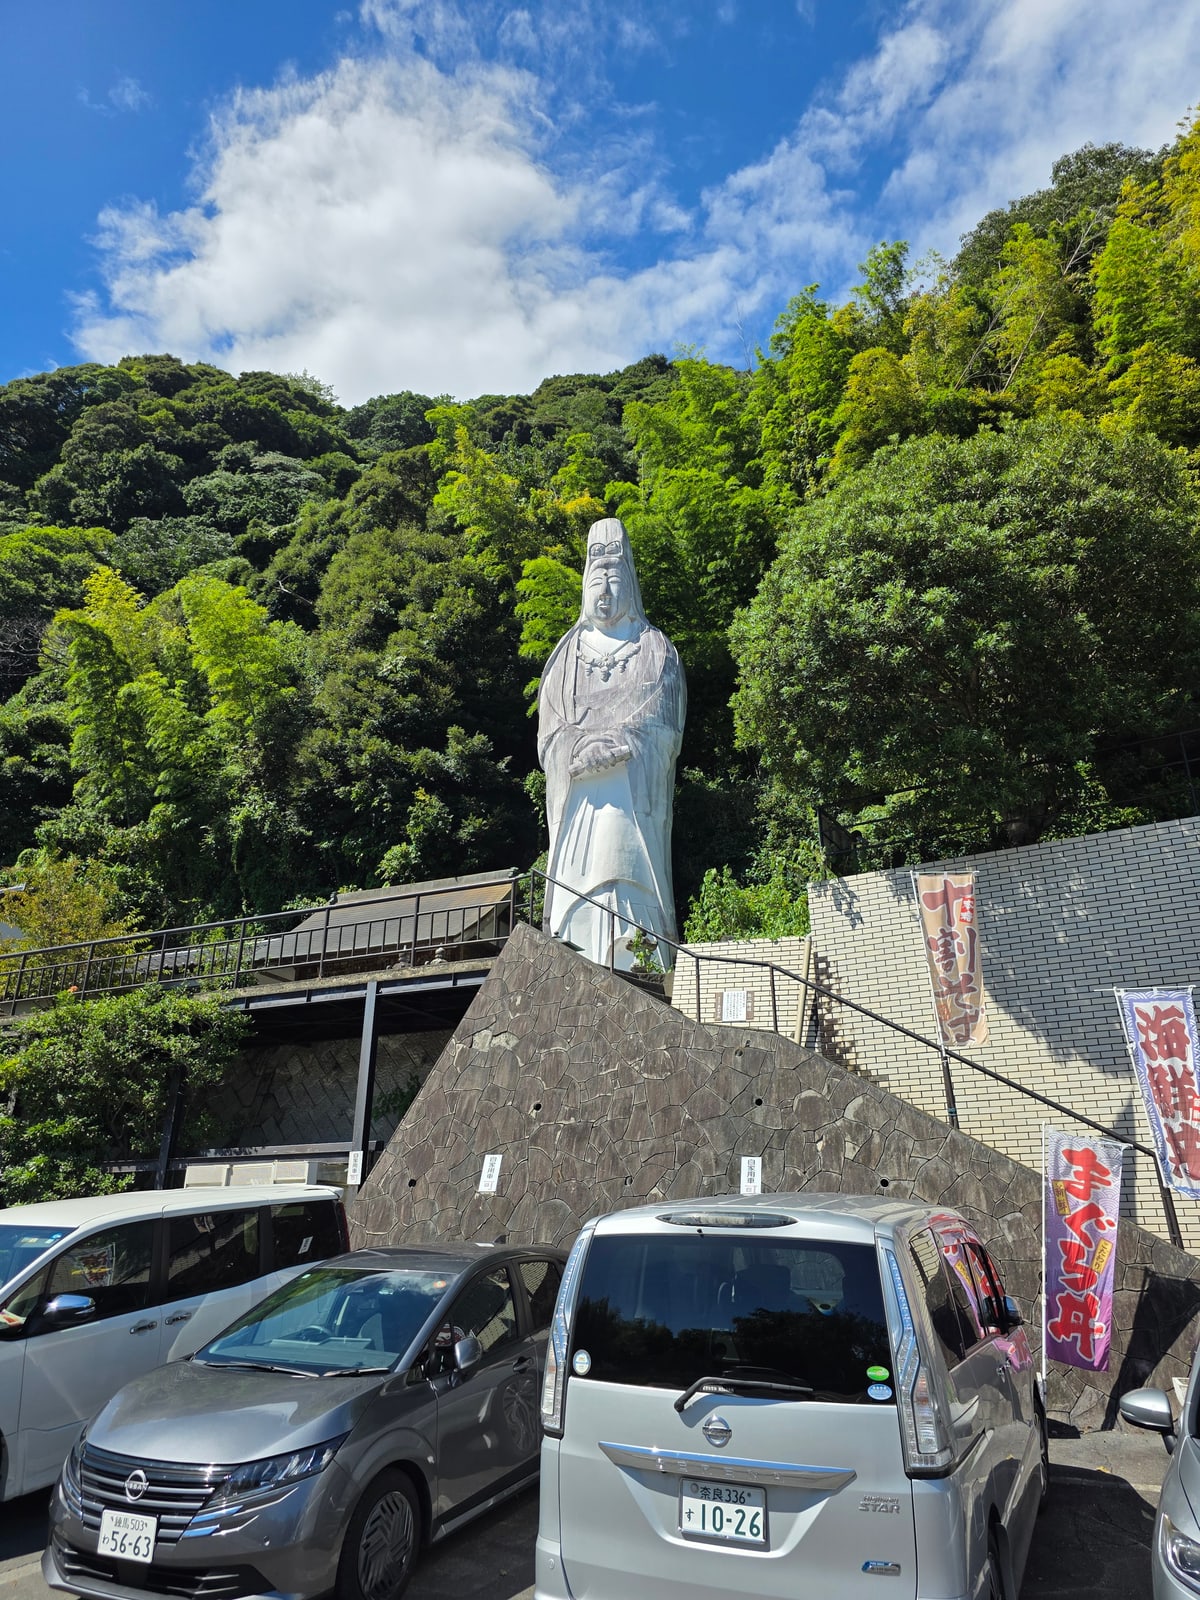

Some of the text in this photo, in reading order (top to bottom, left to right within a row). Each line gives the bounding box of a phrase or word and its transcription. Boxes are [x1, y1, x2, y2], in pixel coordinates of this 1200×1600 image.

[921, 879, 985, 1044] 十割そば
[1135, 1005, 1200, 1180] 海鮮丼
[1048, 1147, 1116, 1361] まぐろ丼
[102, 1530, 151, 1558] わ 56-63
[685, 1503, 761, 1538] す 10-26
[858, 1503, 900, 1514] STAR
